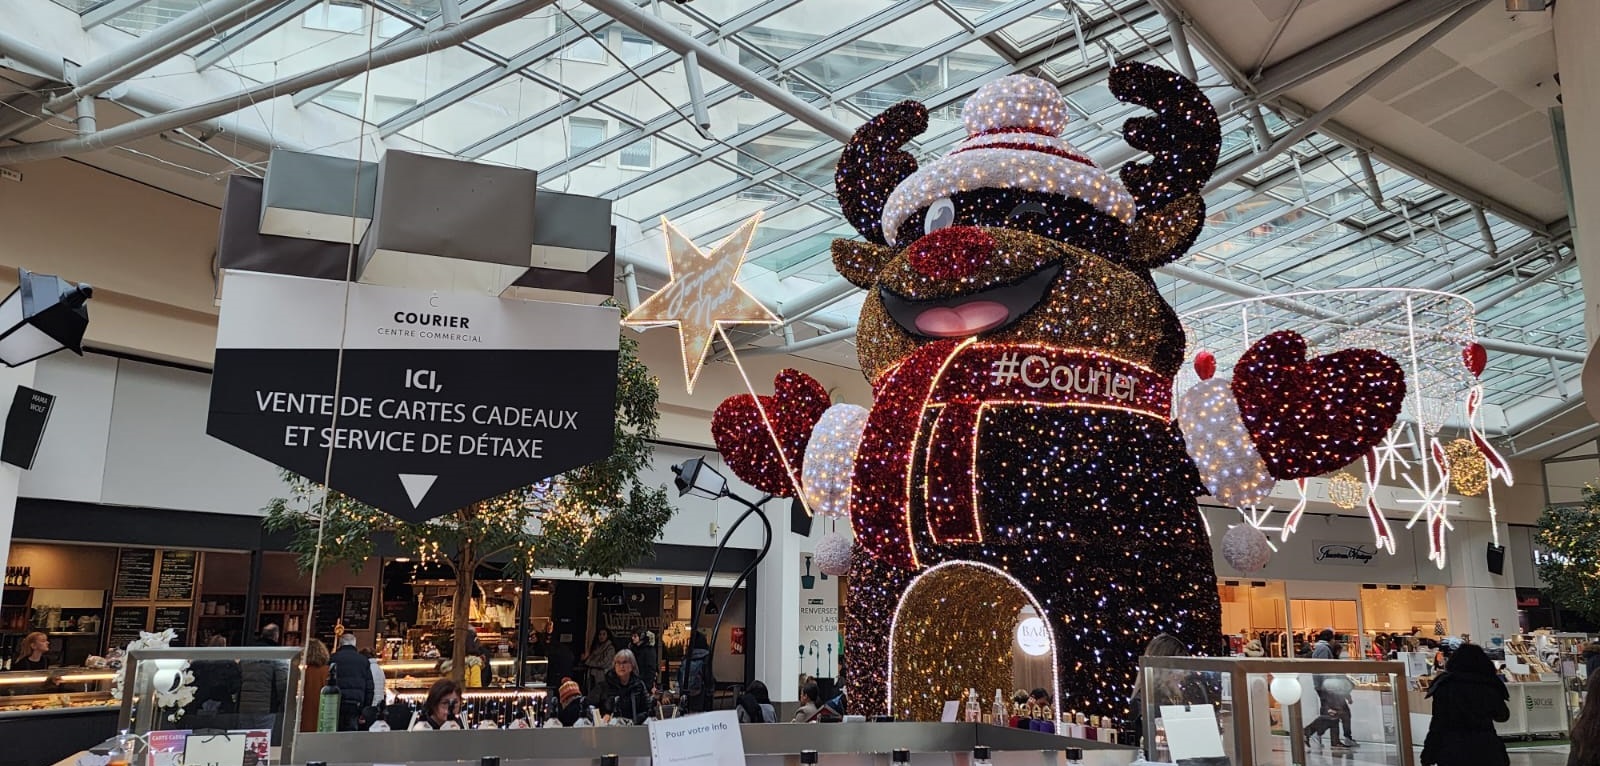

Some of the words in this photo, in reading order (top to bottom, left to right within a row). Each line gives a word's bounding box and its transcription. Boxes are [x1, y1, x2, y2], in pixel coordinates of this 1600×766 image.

[394, 311, 470, 329] COURIER
[377, 327, 416, 338] CENTRE
[419, 331, 483, 344] COMMERCIAL
[405, 368, 443, 393] ICI,
[990, 352, 1139, 402] #Courier
[256, 390, 334, 415] VENTE
[340, 396, 373, 418] DE
[378, 398, 466, 423] CARTES
[472, 404, 579, 430] CADEAUX
[284, 425, 316, 447] ET
[319, 427, 416, 452] SERVICE
[421, 433, 453, 454] DE
[458, 432, 544, 459] DÉTAXE
[800, 607, 838, 615] RENVERSEZ
[665, 729, 685, 739] Pour
[687, 725, 710, 736] votre
